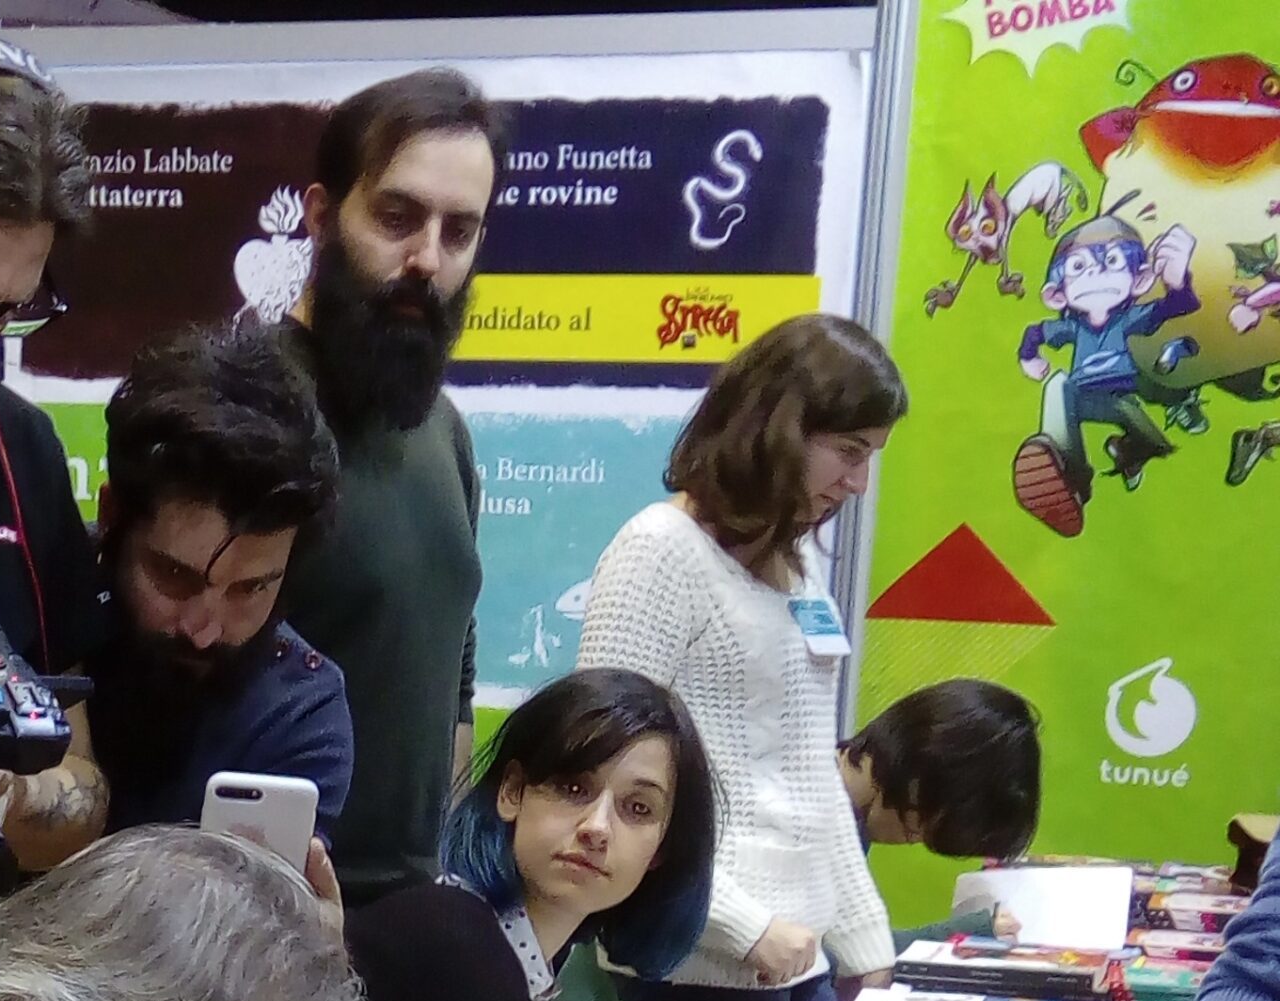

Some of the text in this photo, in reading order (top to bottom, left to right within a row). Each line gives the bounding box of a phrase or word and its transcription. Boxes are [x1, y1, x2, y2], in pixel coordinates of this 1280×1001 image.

[986, 0, 1117, 39] BOMBA
[143, 146, 234, 174] Labbate
[556, 143, 653, 171] Funetta
[526, 177, 619, 207] rovine
[570, 305, 593, 332] al
[496, 455, 606, 484] Bernardi
[1099, 759, 1190, 788] tunué
